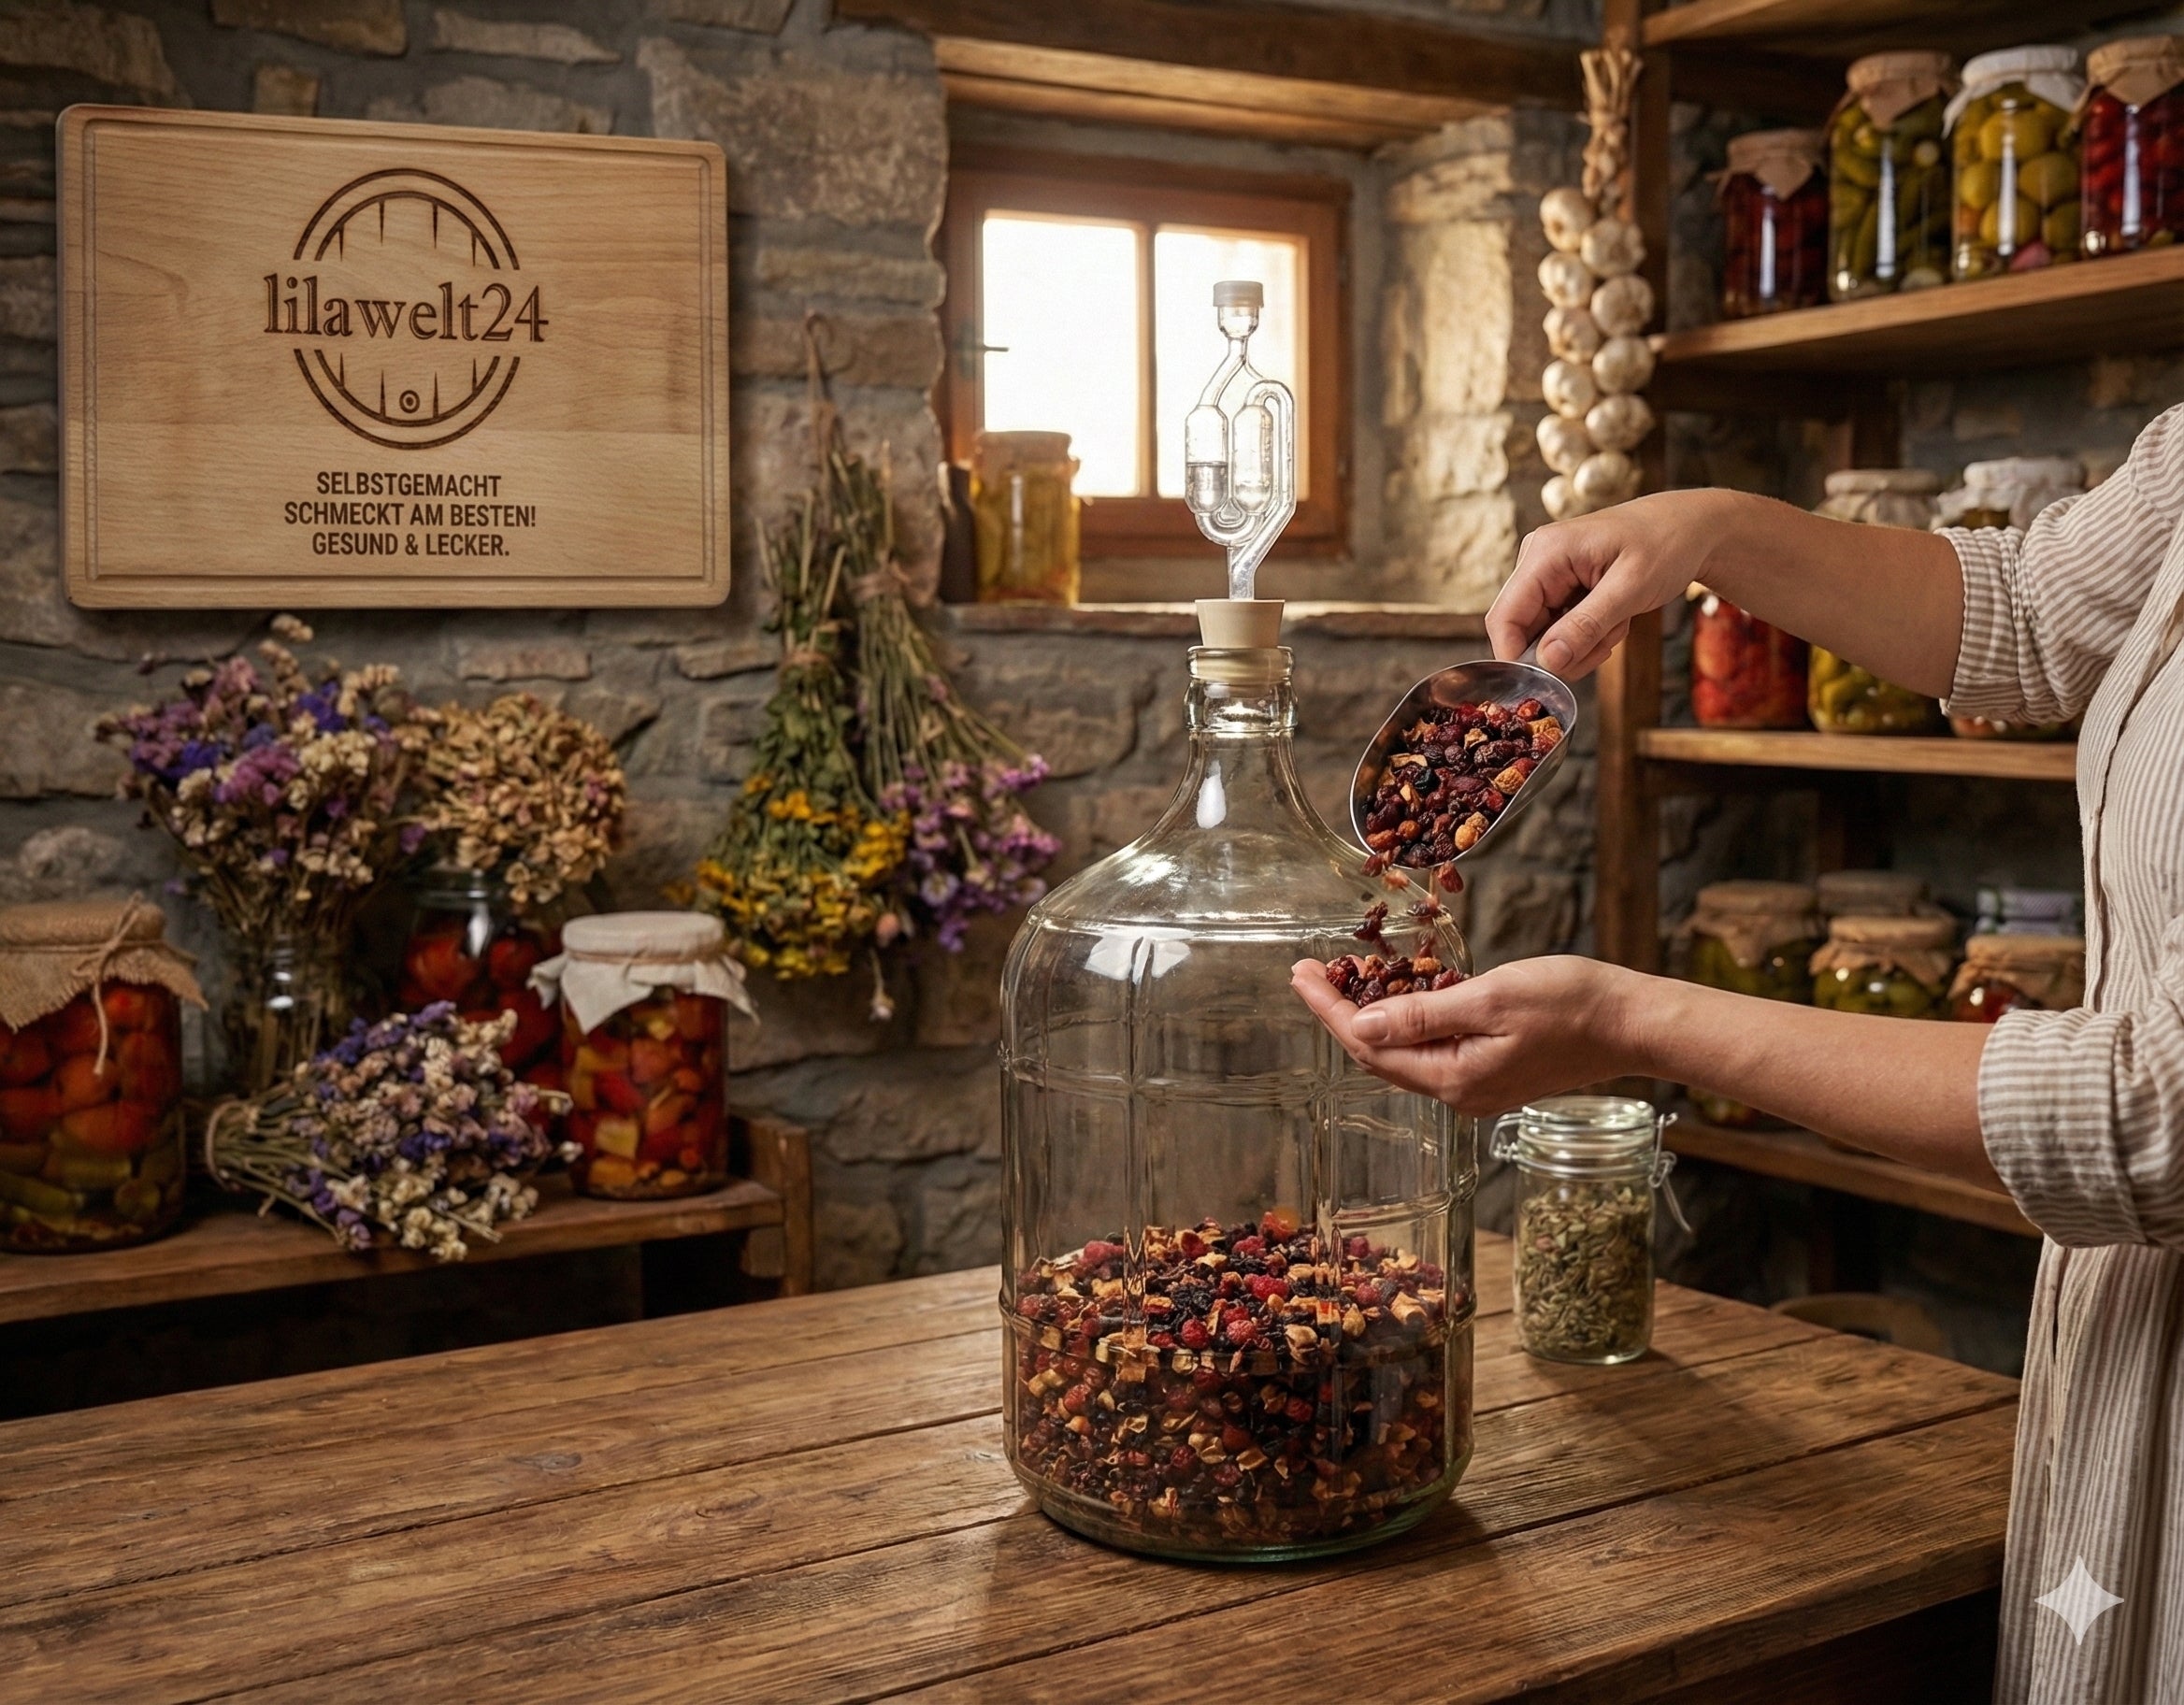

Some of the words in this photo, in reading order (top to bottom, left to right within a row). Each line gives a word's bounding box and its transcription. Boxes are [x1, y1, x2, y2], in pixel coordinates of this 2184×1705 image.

[263, 273, 549, 342] lilawelt24
[316, 471, 502, 497] SELBSTGEMACHT
[284, 501, 405, 525] SCHMECKT
[410, 504, 443, 526] AM
[450, 504, 536, 527] BESTEN!
[311, 532, 398, 555] GESUND
[405, 534, 419, 555] &
[425, 534, 510, 557] LECKER.
